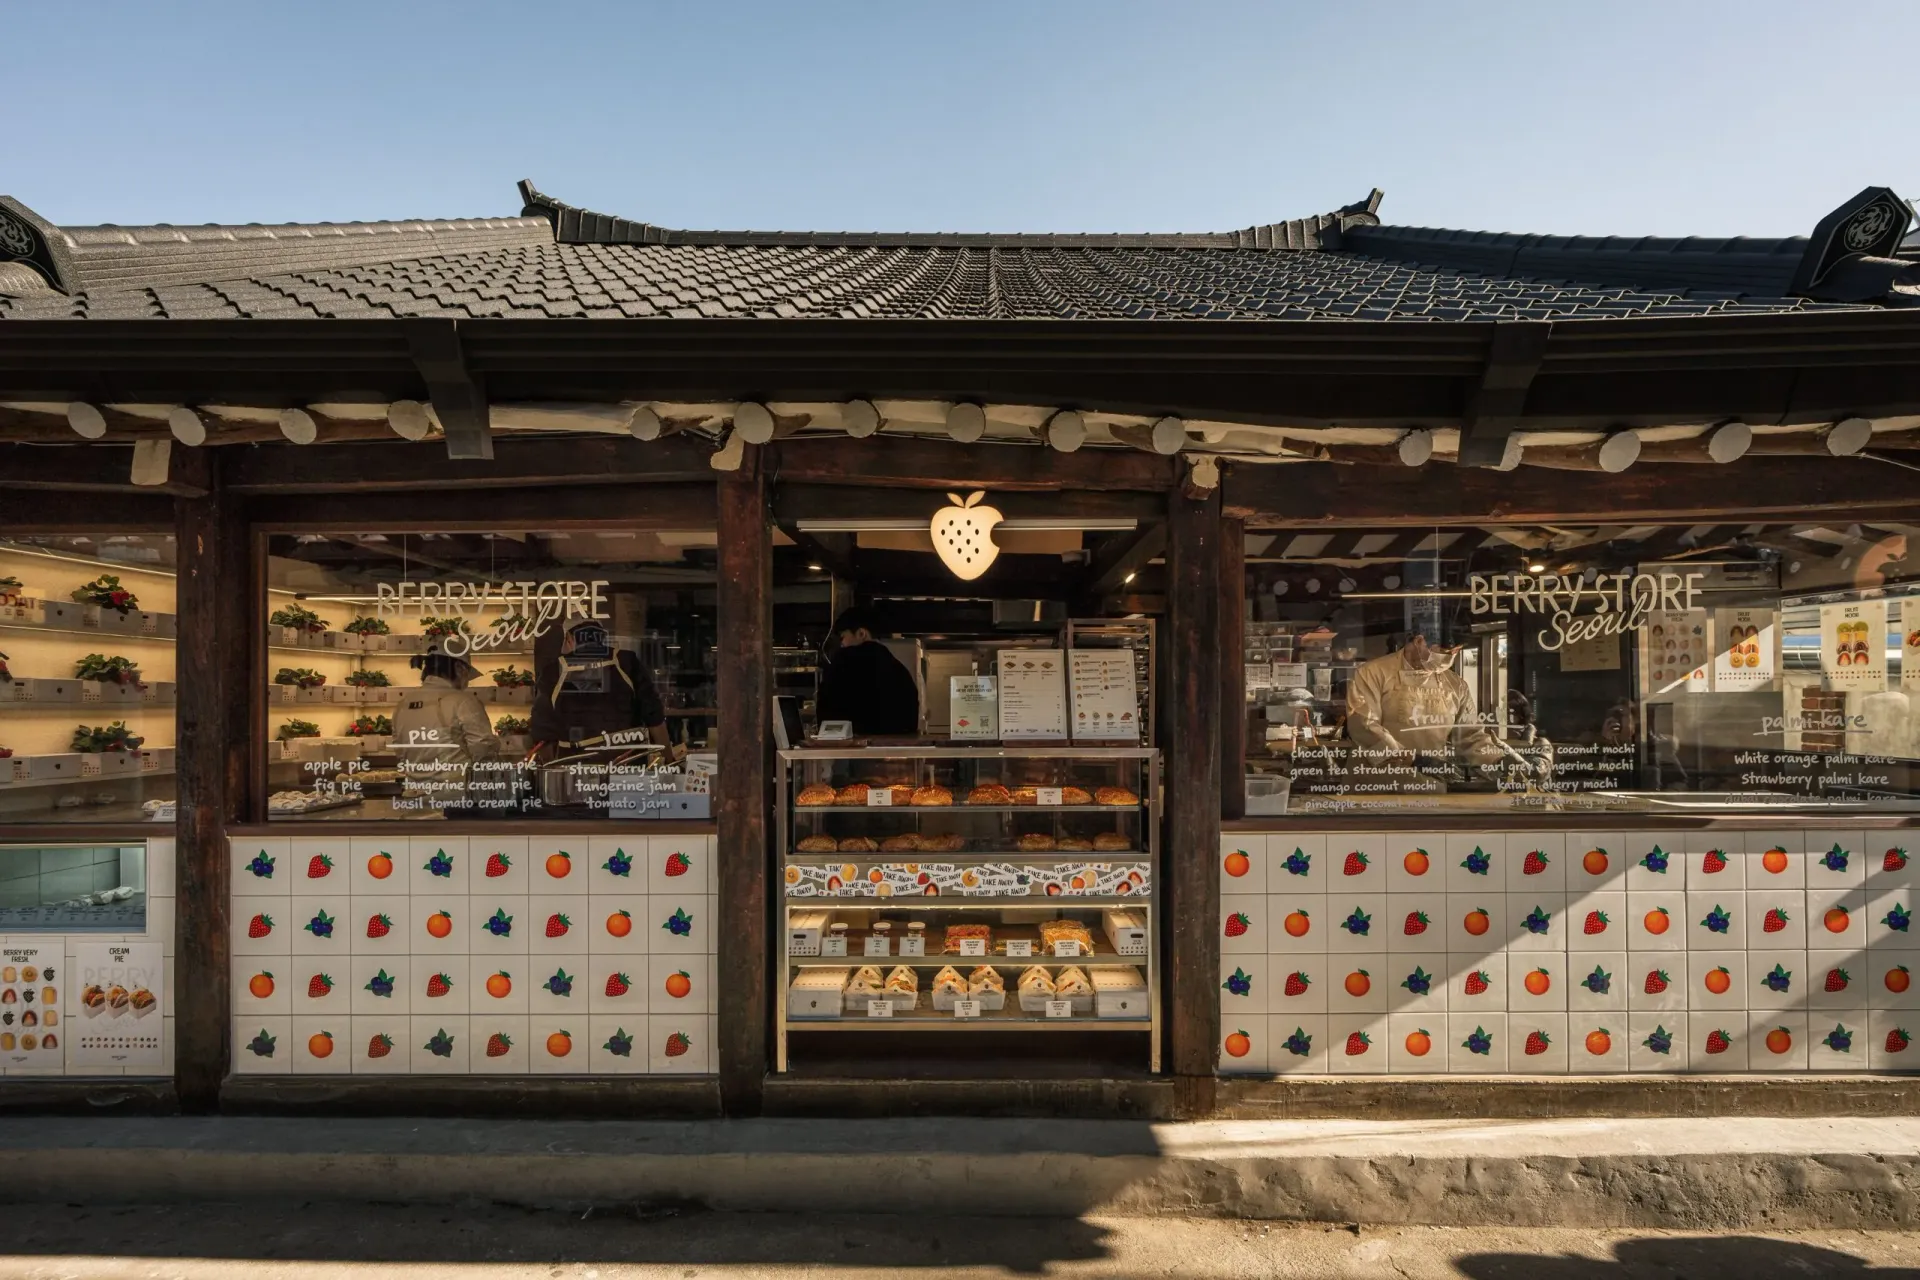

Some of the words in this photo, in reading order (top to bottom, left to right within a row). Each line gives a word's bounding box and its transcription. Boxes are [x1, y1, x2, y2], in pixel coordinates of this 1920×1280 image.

[377, 581, 491, 620] BERRY
[501, 580, 611, 620] STORE
[1470, 574, 1584, 615] BERRY
[1595, 573, 1706, 613] STORE
[444, 598, 552, 658] Seoul
[1538, 591, 1649, 651] Seoul
[1762, 710, 1813, 736] palmi
[1819, 710, 1868, 729] kare
[408, 727, 440, 745] pie
[601, 730, 644, 750] jam
[1291, 746, 1347, 759] chocolate
[1351, 745, 1417, 761] strawberry
[1421, 746, 1456, 758] mochi
[1557, 743, 1600, 755] coconut
[1602, 743, 1636, 755] mochi
[304, 756, 342, 776] apple
[348, 757, 371, 776] pie
[397, 758, 469, 777] strawberry
[472, 760, 513, 772] cream
[517, 758, 538, 777] pie
[1481, 761, 1504, 772] earl
[1598, 759, 1634, 772] mochi
[1735, 751, 1770, 765] white
[1774, 755, 1820, 768] orange
[1825, 751, 1859, 769] palmi
[1865, 753, 1897, 765] kare
[569, 761, 646, 778] strawberry
[652, 762, 681, 778] jam
[1290, 766, 1323, 781] green
[1327, 765, 1349, 776] tea
[1353, 764, 1418, 778] strawberry
[1421, 763, 1456, 774] mochi
[312, 777, 335, 798] fig
[341, 777, 363, 798] pie
[402, 779, 465, 795] tangerine
[468, 779, 506, 791] cream
[511, 777, 532, 796] pie
[575, 779, 645, 797] tangerine
[648, 780, 677, 796] jam
[1310, 783, 1350, 796] mango
[1354, 780, 1400, 791] coconut
[1403, 780, 1437, 791] mochi
[1583, 777, 1618, 790] mochi
[1818, 772, 1852, 789] palmi
[1858, 773, 1890, 785] kare
[392, 796, 423, 811] basil
[429, 797, 474, 810] tomato
[478, 798, 517, 809] cream
[521, 796, 543, 812] pie
[584, 797, 637, 810] tomato
[639, 798, 670, 814] jam
[1305, 799, 1357, 813] pineapple
[1361, 799, 1402, 809] coconut
[883, 872, 896, 880] TAKE
[976, 868, 988, 876] TAKE
[1056, 866, 1070, 874] TAKE
[1113, 870, 1125, 878] AWAY
[796, 886, 812, 896] AWAY
[1010, 887, 1026, 895] AWAY
[22, 948, 38, 956] VERY
